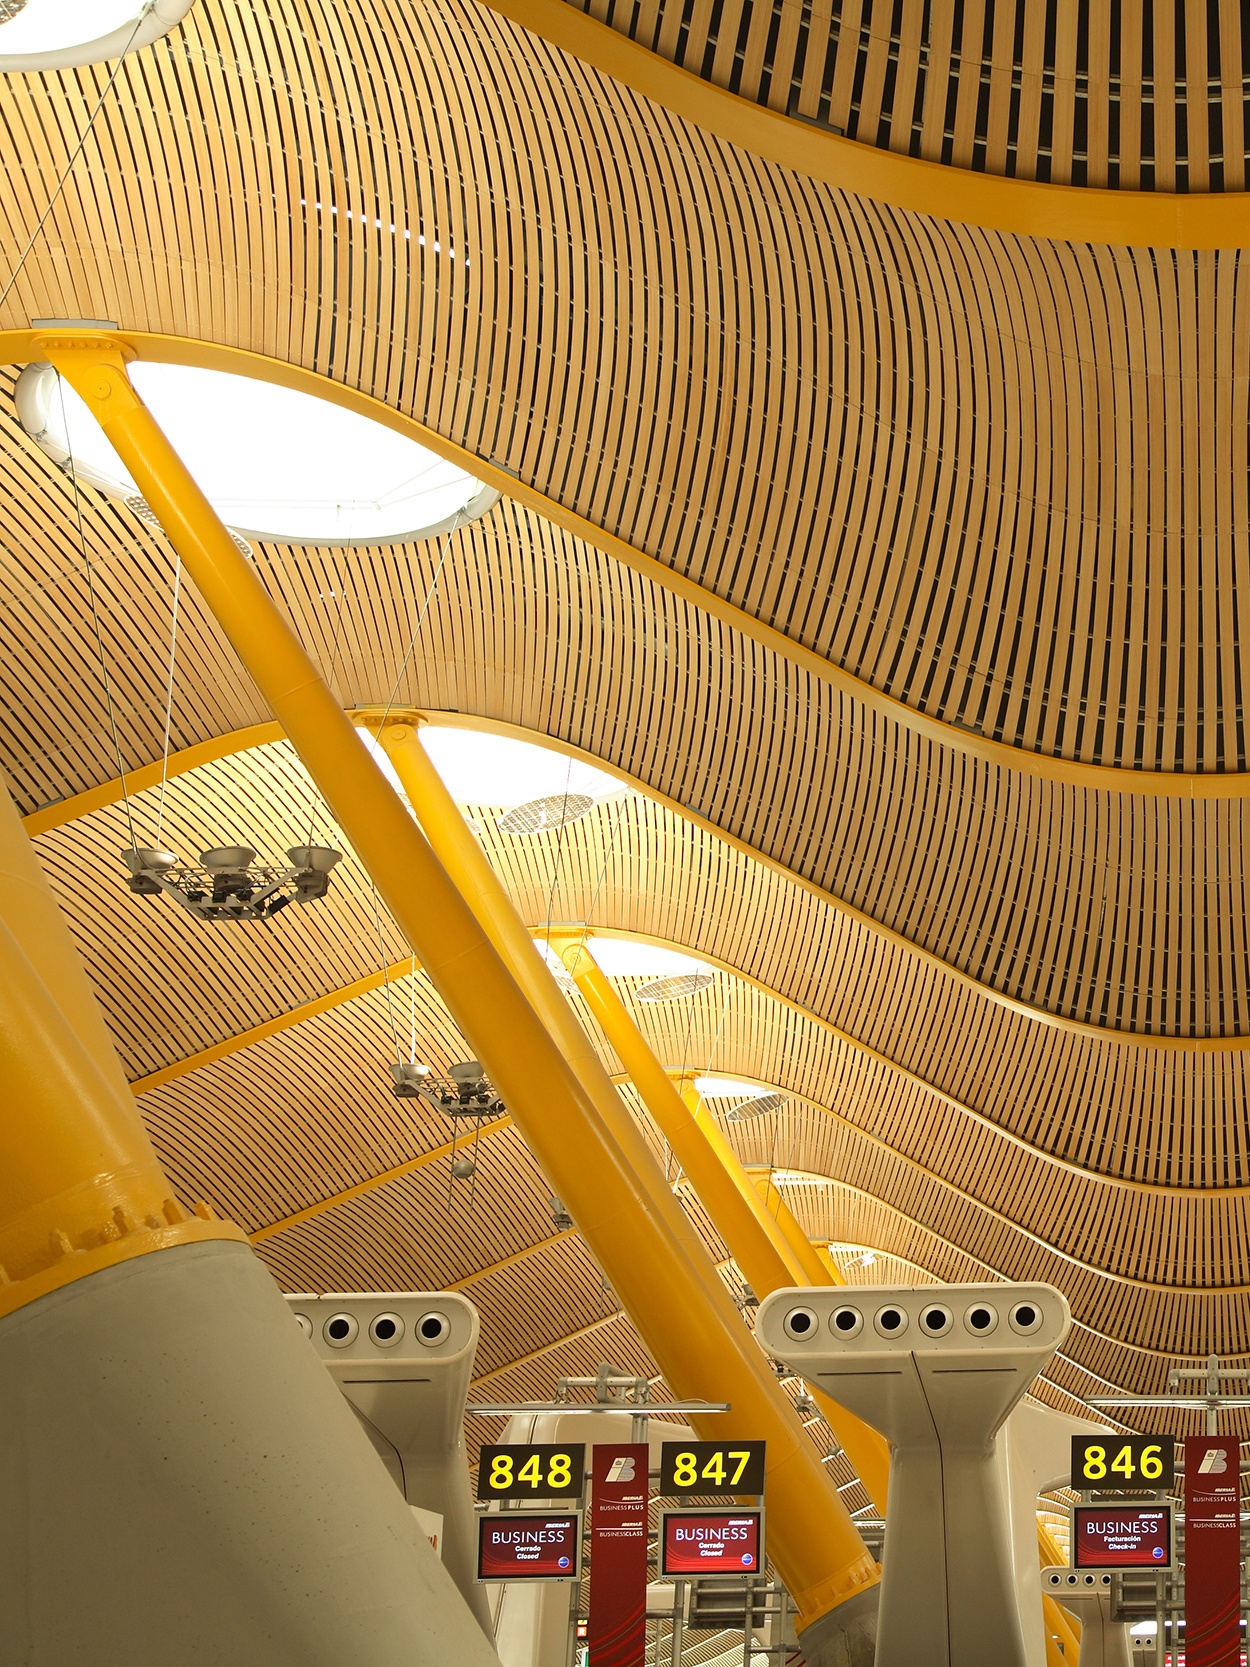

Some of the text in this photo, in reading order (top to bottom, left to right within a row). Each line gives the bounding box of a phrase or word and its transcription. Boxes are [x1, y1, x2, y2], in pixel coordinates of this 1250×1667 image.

[489, 1454, 571, 1489] 848
[673, 1451, 750, 1487] 847
[1083, 1445, 1163, 1480] 846
[492, 1531, 564, 1544] BUSINESS
[675, 1528, 748, 1541] BUSINESS
[1086, 1521, 1158, 1534] BUSINESS
